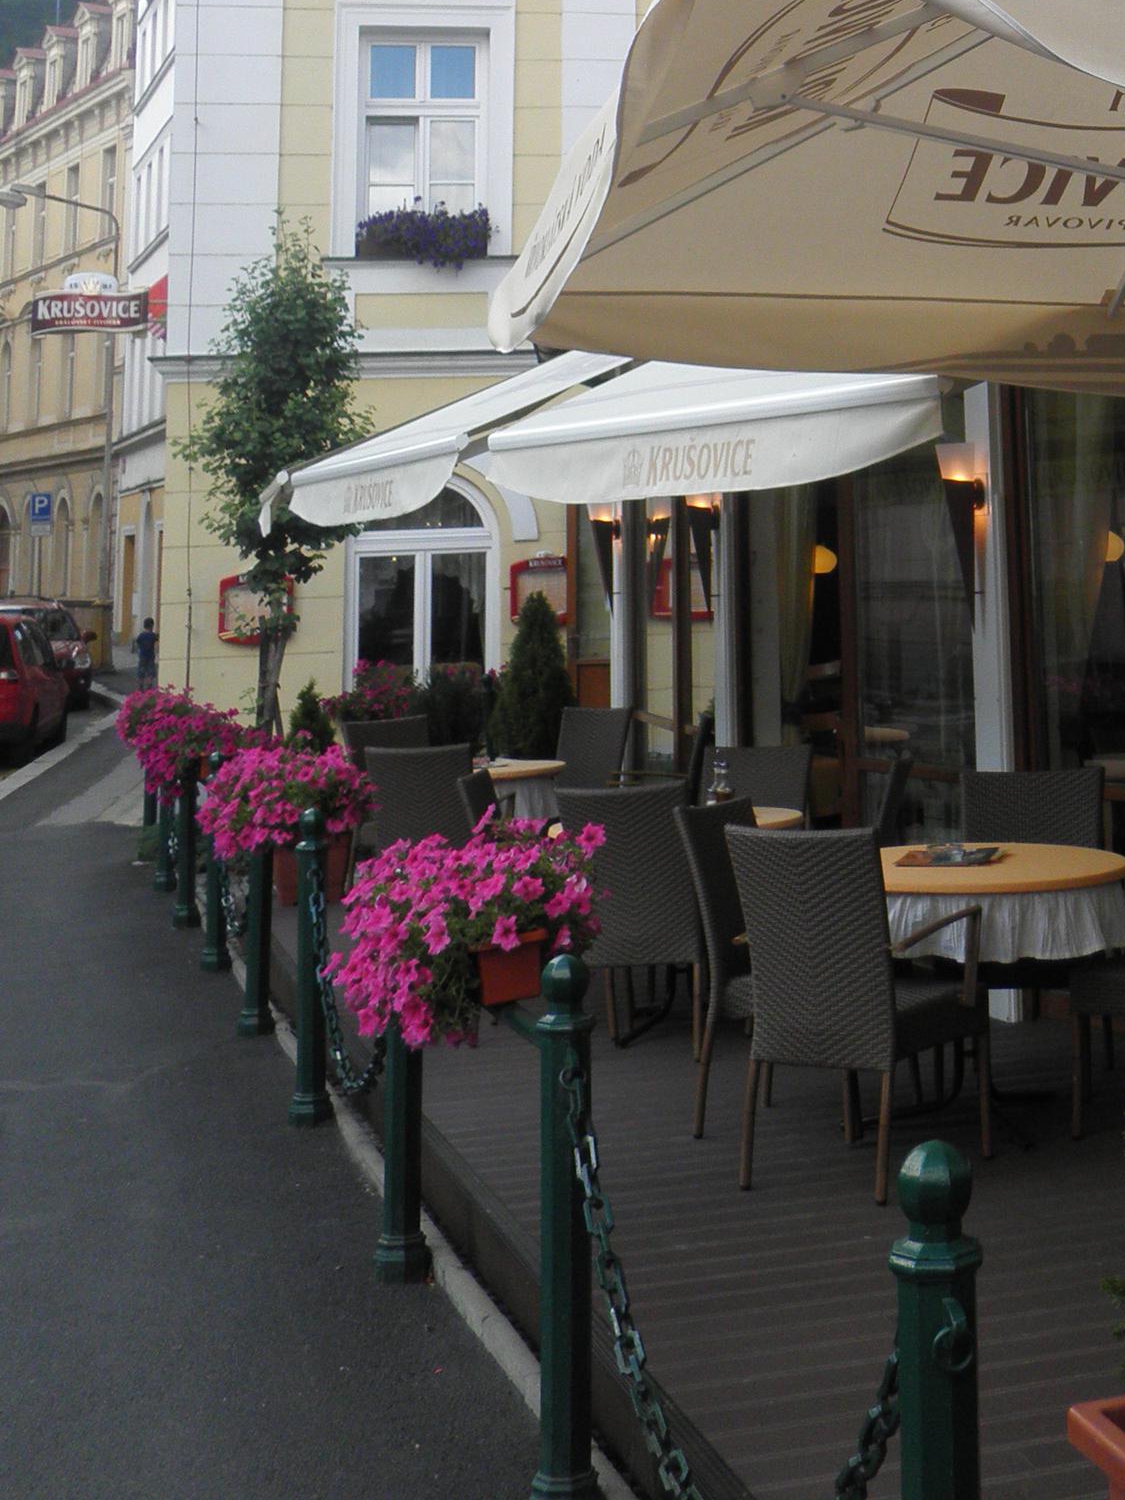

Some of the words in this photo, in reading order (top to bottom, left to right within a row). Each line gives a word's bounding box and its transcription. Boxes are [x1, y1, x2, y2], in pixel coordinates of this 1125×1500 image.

[37, 297, 140, 320] KRUŠOVICE
[646, 436, 756, 487] KRUŠOVICE
[35, 496, 48, 514] P
